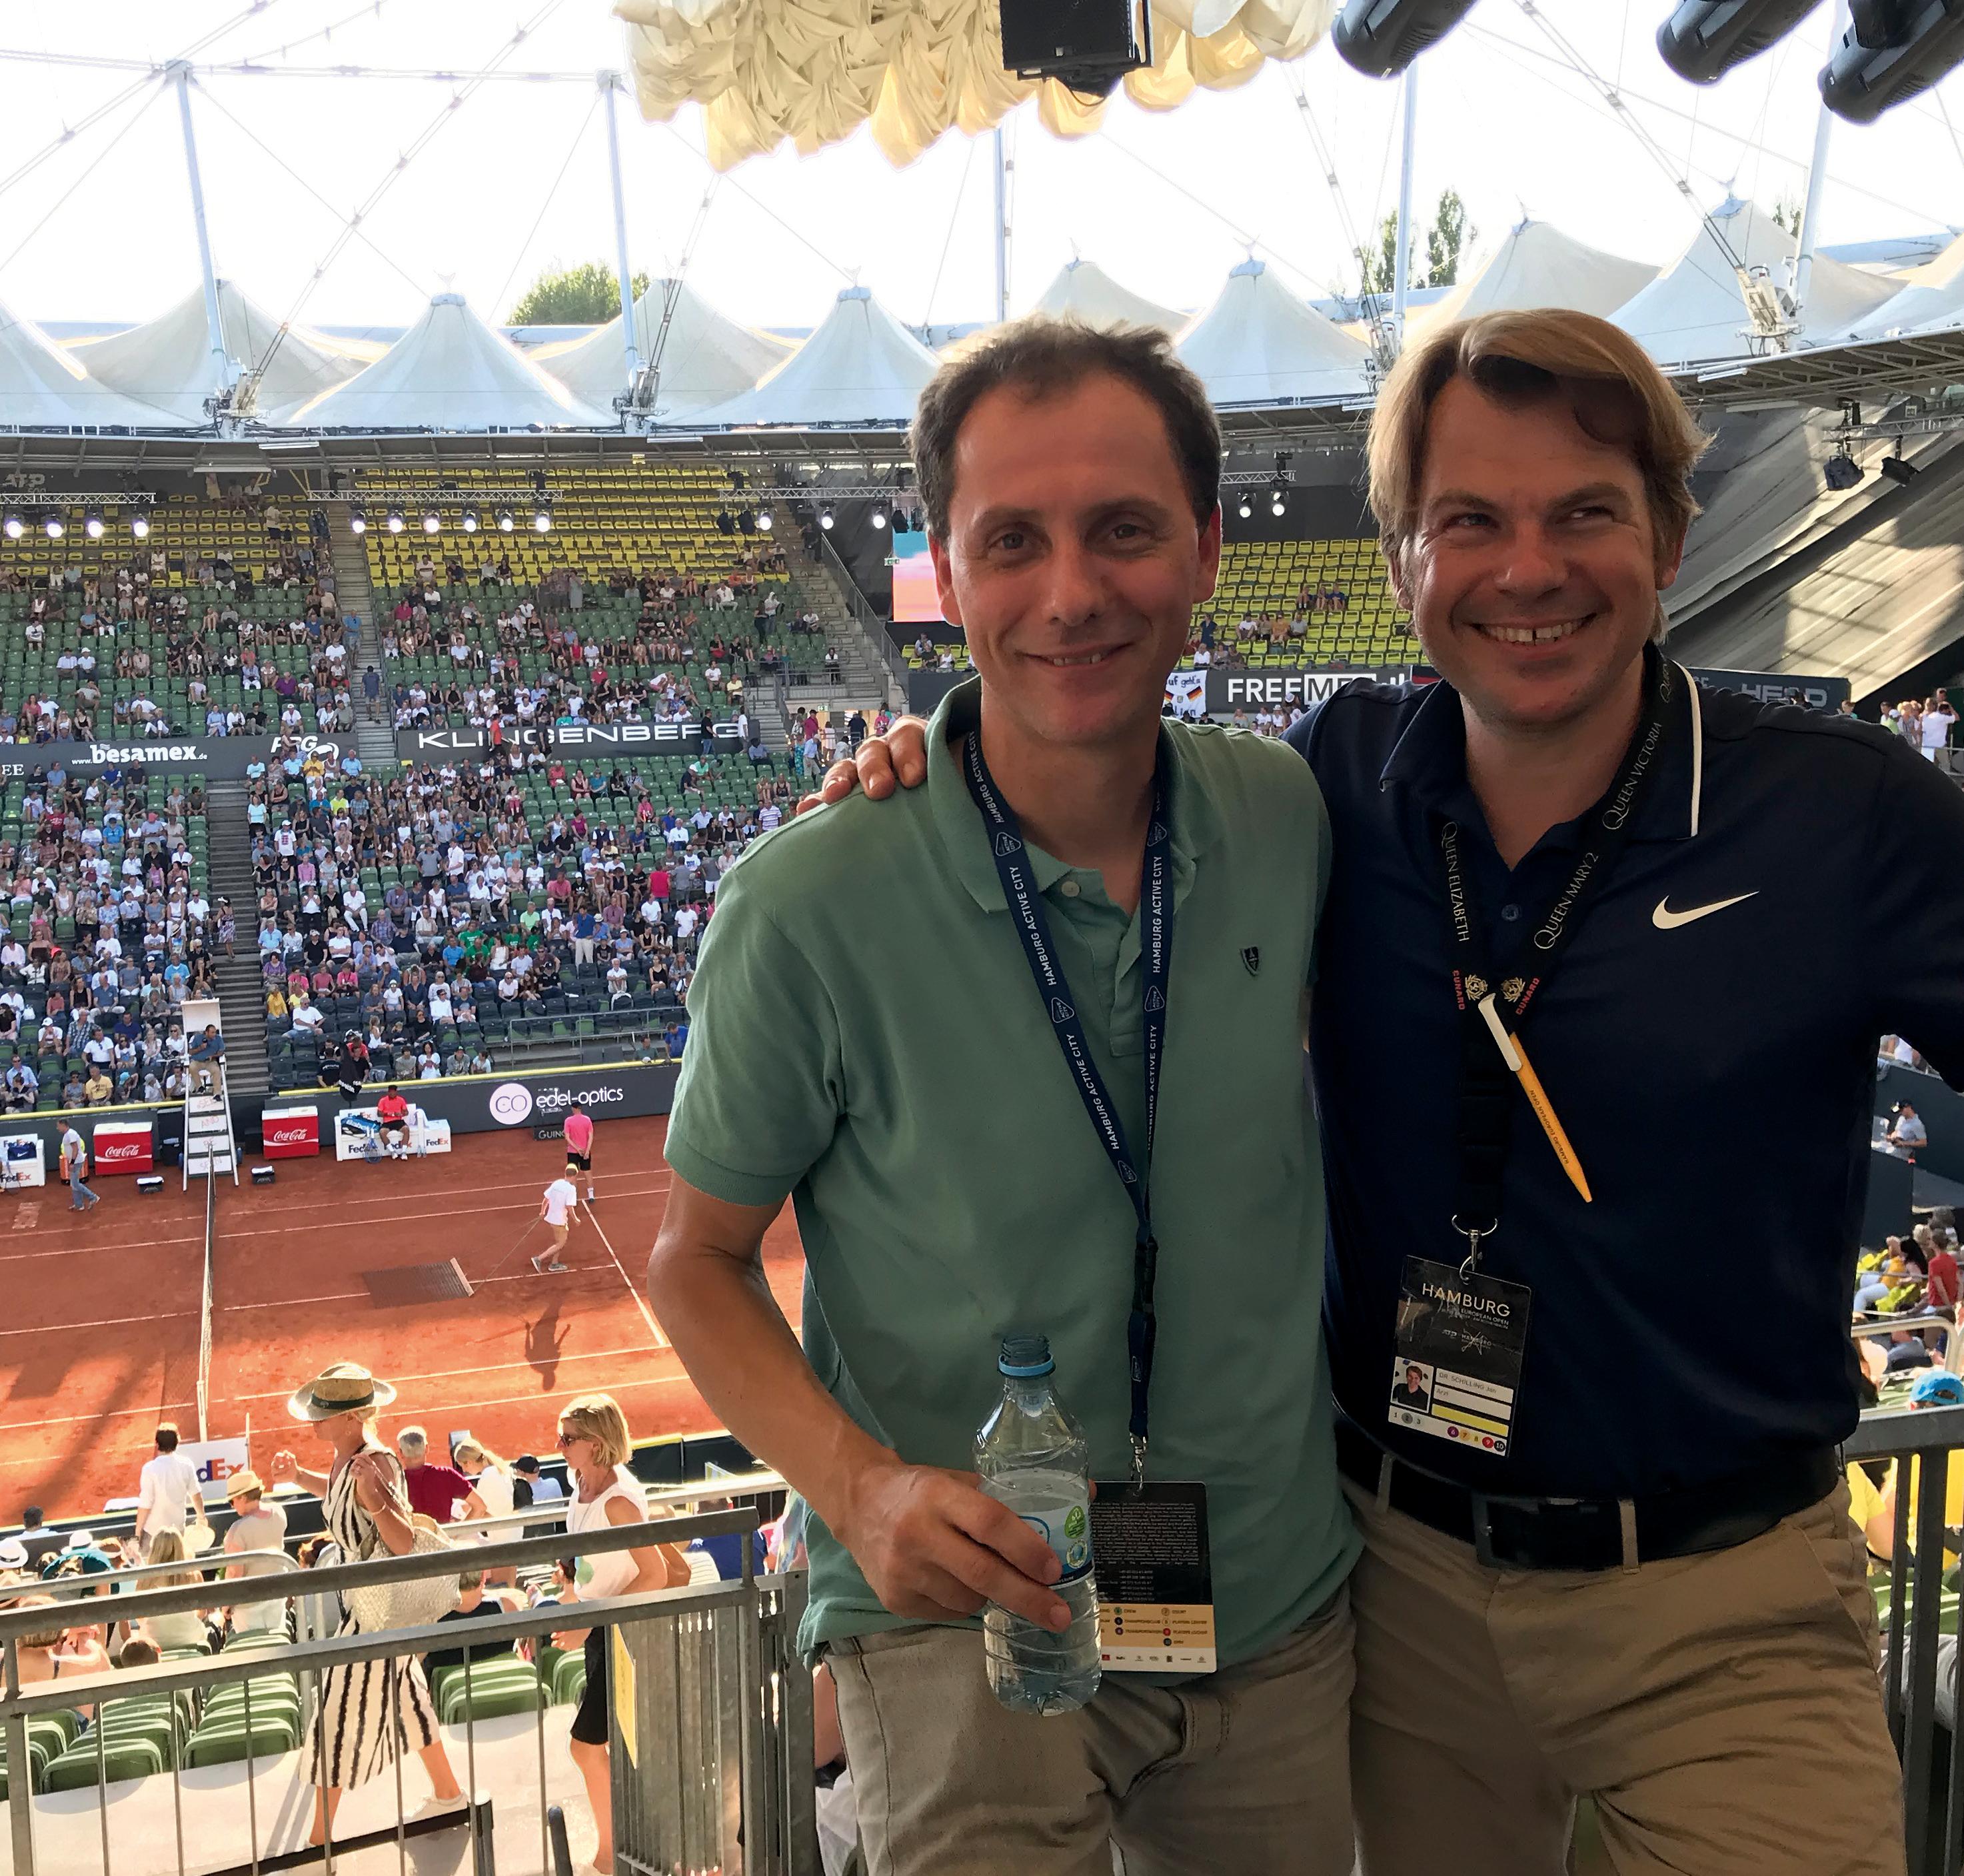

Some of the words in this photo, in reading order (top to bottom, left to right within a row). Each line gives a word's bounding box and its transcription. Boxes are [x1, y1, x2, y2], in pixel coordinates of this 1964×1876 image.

[3, 474, 45, 487] ATP
[1741, 684, 1828, 708] HED
[970, 751, 984, 782] ACTIVE
[1602, 779, 1637, 830] QUEEN
[1630, 722, 1663, 776] VICTORIA
[980, 784, 1005, 823] HAMBURG
[1442, 821, 1458, 872] QUEEN
[1009, 866, 1024, 890] CITY
[1153, 856, 1162, 878] CITY
[1017, 891, 1036, 930] ACTIVE
[1152, 878, 1162, 916] ACTIVE
[1448, 874, 1470, 942] ELIZABETH
[1533, 898, 1572, 950] QUEEN
[1564, 862, 1591, 897] MARY
[1585, 852, 1599, 864] 2
[1031, 932, 1057, 986] HAMBURG
[1152, 918, 1162, 973] HAMBURG
[1452, 969, 1466, 1010] CUNARD
[1515, 976, 1541, 1015] CUNARD
[1066, 1034, 1081, 1057] CITY
[1076, 1059, 1098, 1096] ACTIVE
[536, 1086, 624, 1108] edel-optics
[1093, 1098, 1120, 1150] HAMBURG
[1422, 1283, 1510, 1317] HAMBURG
[196, 1458, 245, 1483] dEx
